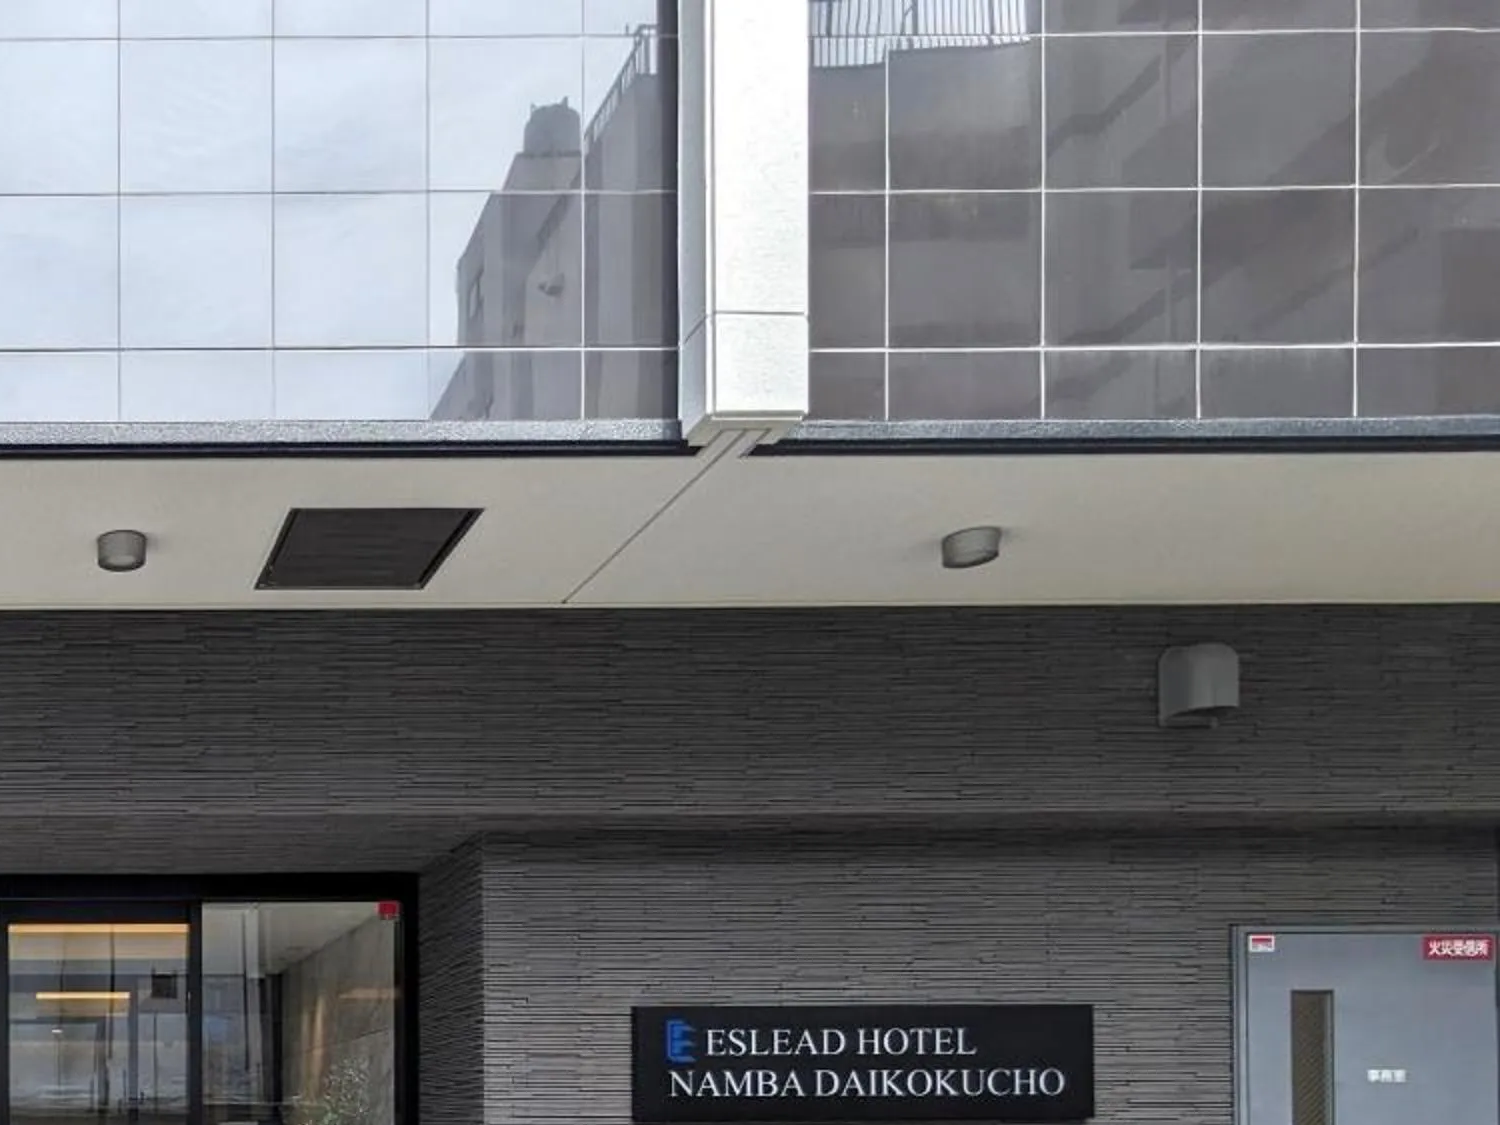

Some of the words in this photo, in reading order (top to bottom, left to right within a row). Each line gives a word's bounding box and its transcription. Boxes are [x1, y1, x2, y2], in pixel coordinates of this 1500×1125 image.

[707, 1028, 846, 1056] ESLEAD
[857, 1027, 977, 1055] HOTEL
[669, 1070, 805, 1097] NAMBA
[815, 1068, 1066, 1096] DAIKOKUCHO
